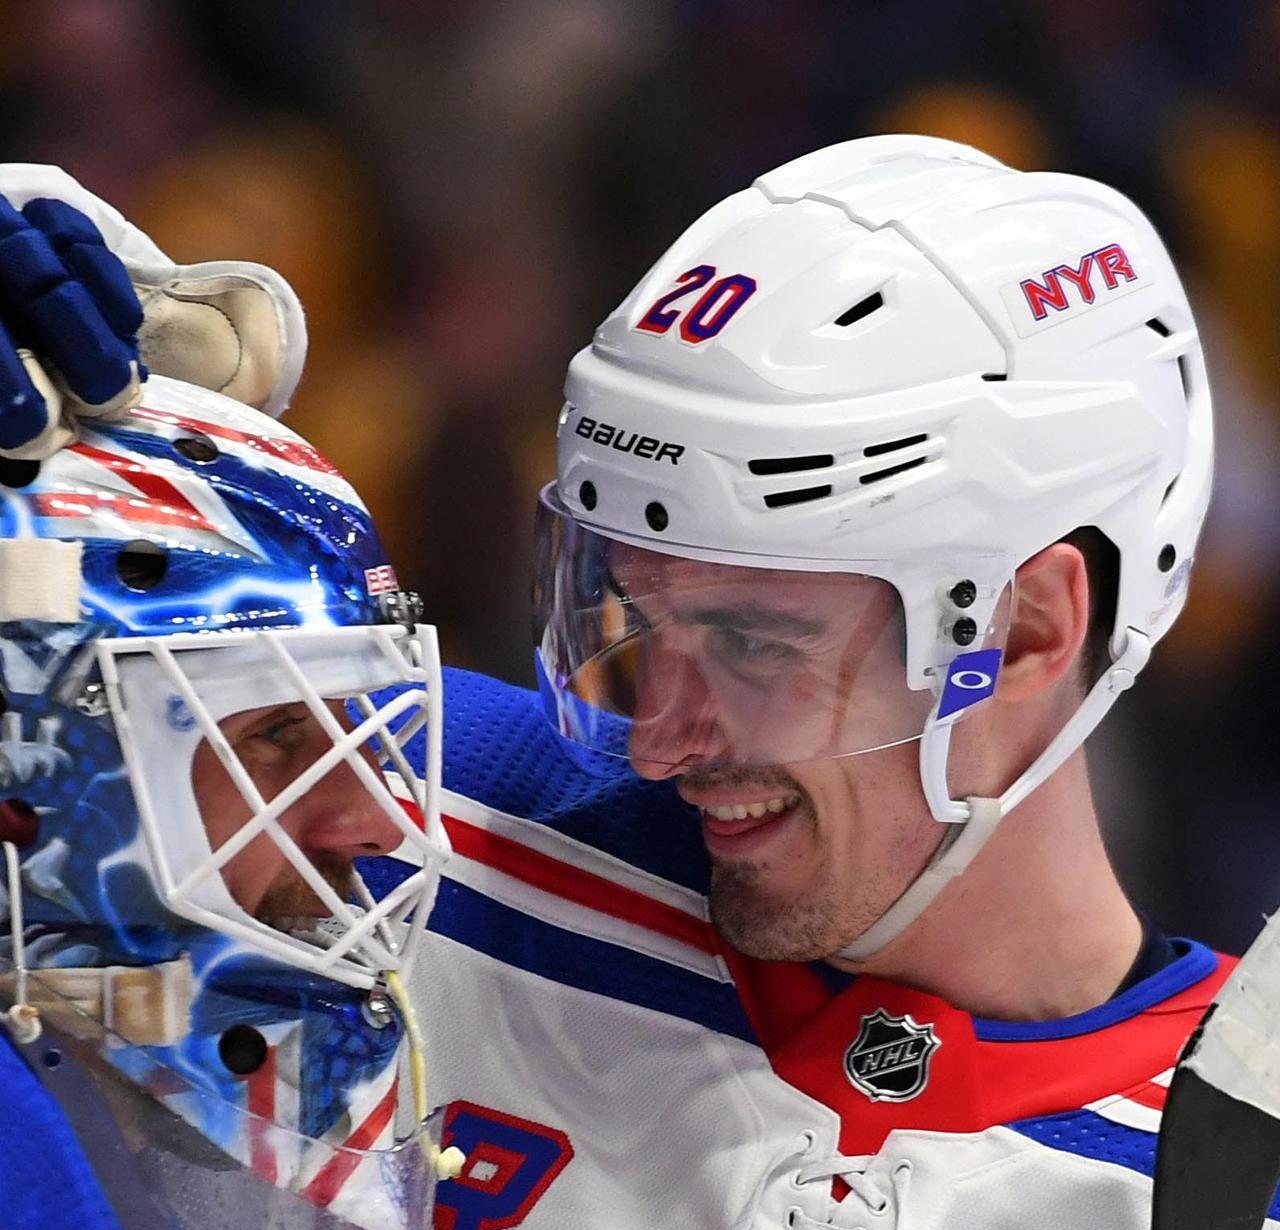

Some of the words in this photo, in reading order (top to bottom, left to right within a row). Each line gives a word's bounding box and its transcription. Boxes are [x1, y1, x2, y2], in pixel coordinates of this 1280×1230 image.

[635, 264, 758, 344] 20
[1019, 243, 1138, 321] NYR
[859, 1041, 919, 1074] NHL
